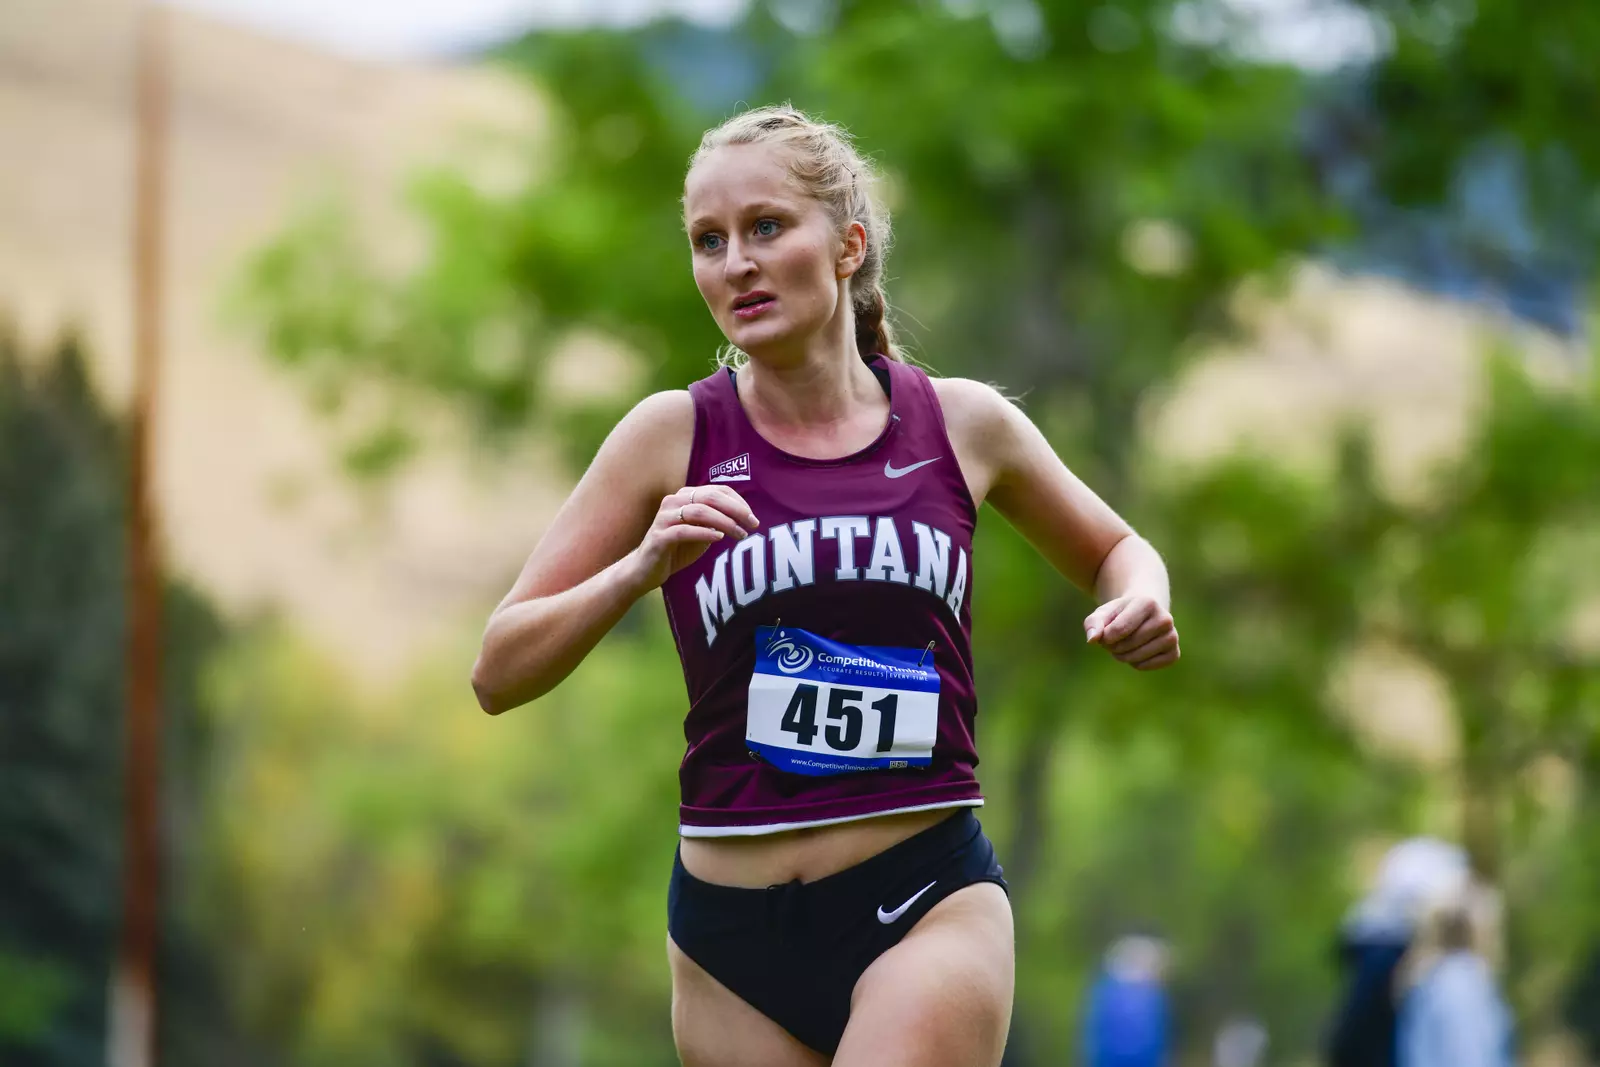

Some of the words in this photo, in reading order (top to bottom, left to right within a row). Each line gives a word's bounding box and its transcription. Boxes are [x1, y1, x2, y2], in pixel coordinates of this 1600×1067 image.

[695, 515, 967, 648] MONTANA
[818, 665, 853, 675] ACCURATE
[855, 669, 884, 678] RESULTS
[889, 672, 910, 680] EVERY
[912, 674, 929, 682] TIME
[780, 683, 898, 752] 451
